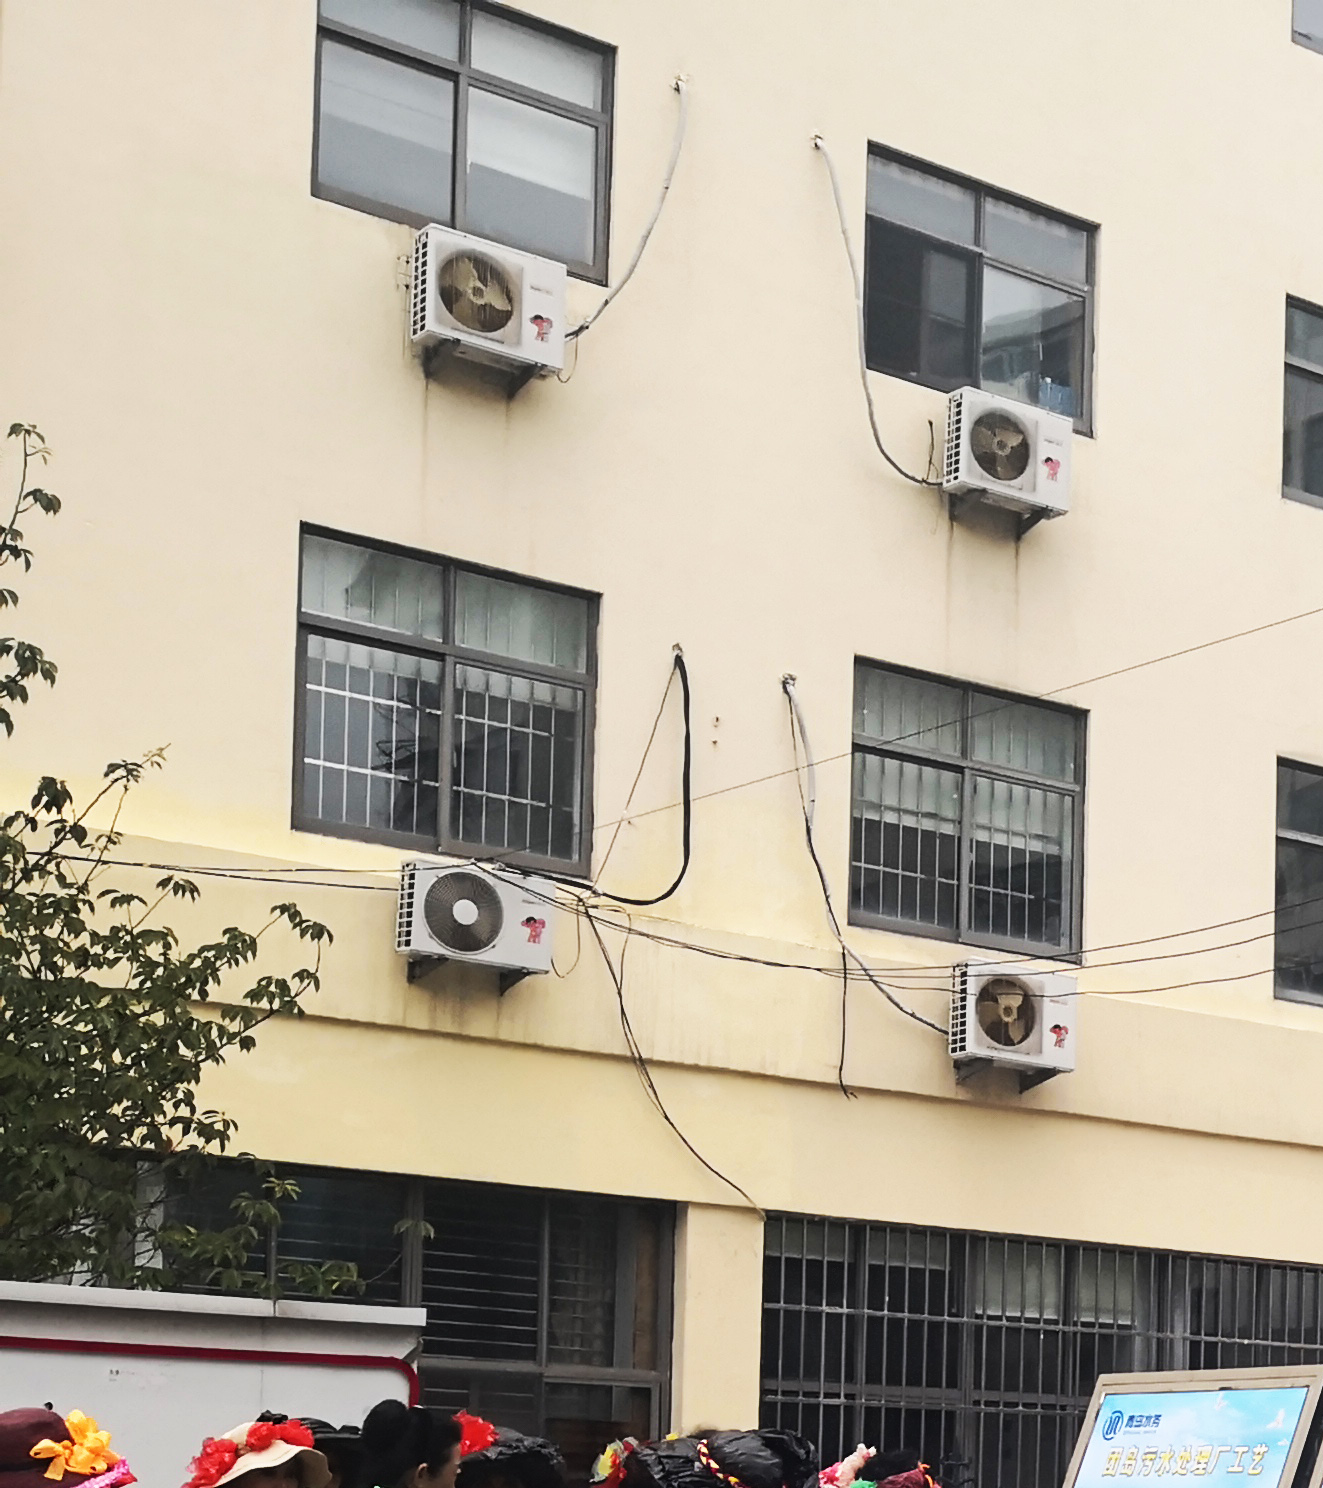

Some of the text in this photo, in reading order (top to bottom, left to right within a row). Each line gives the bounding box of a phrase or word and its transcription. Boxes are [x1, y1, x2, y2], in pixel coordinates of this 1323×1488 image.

[1101, 1443, 1270, 1477] 团岛污水处理厂工艺
